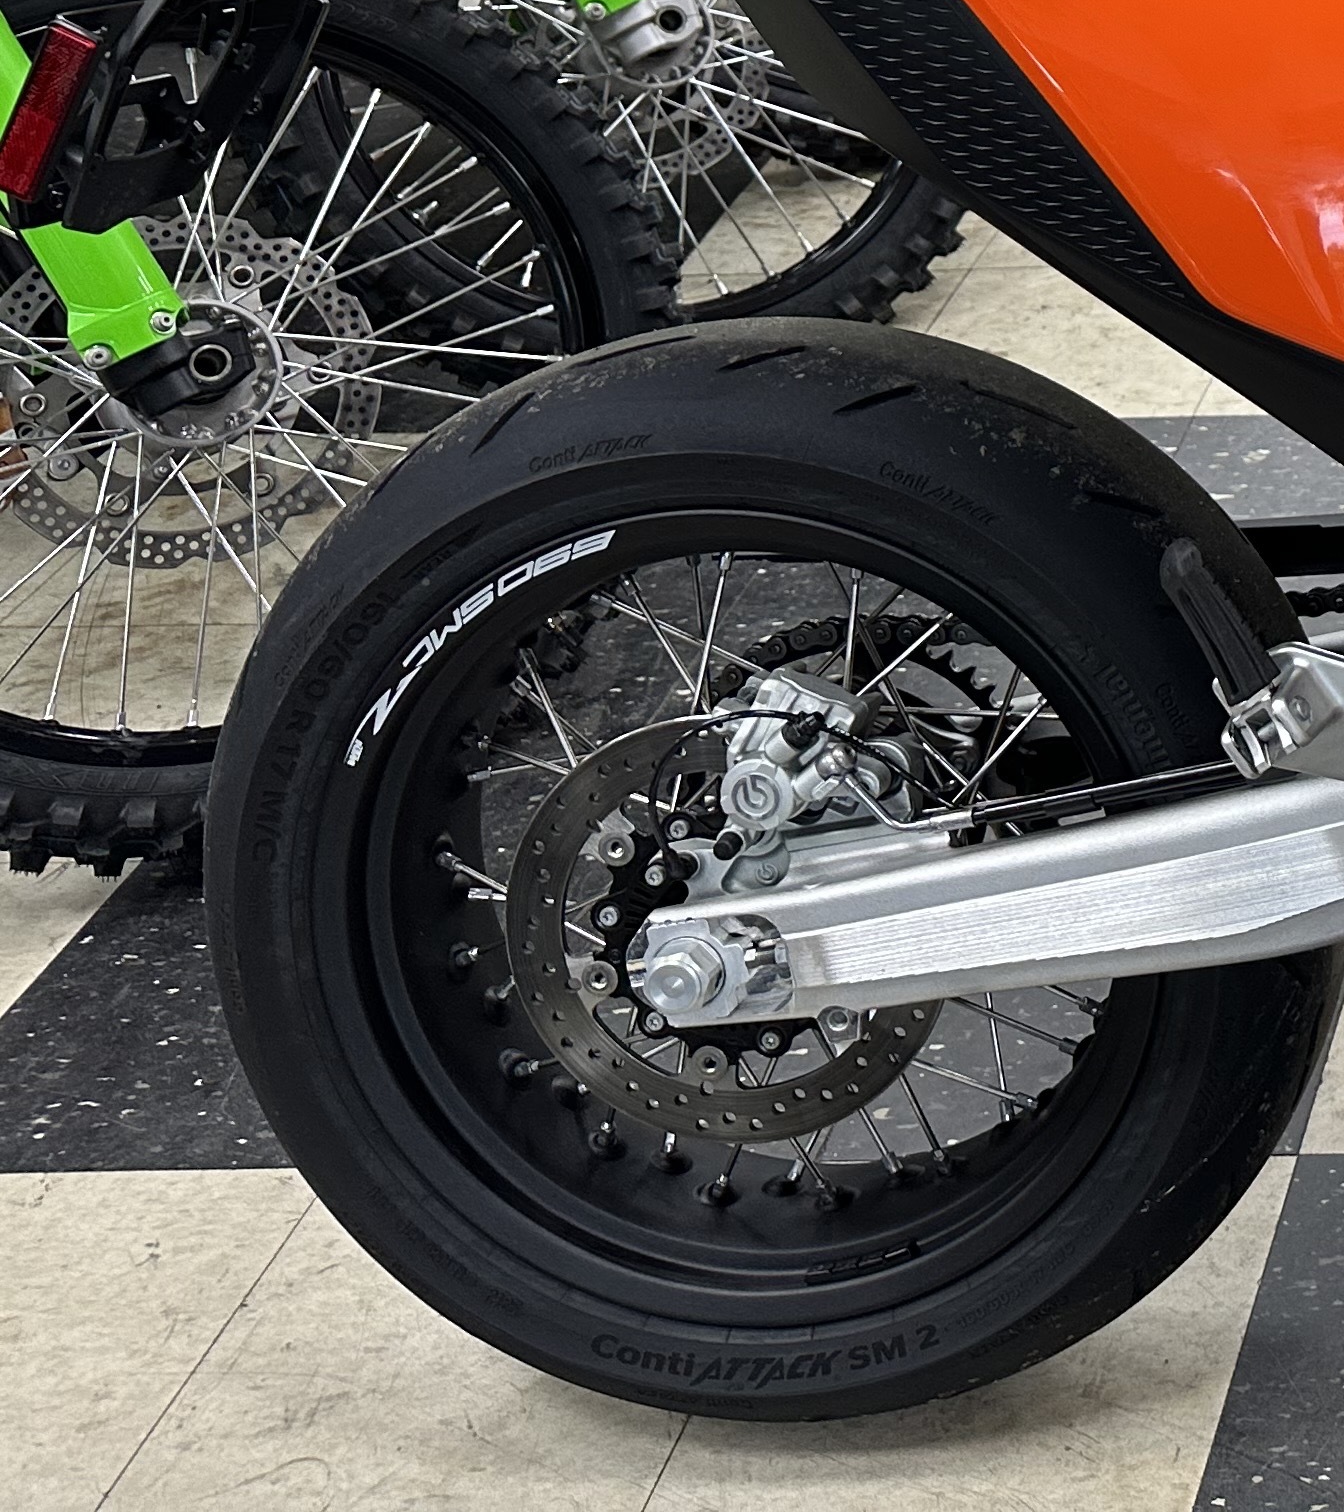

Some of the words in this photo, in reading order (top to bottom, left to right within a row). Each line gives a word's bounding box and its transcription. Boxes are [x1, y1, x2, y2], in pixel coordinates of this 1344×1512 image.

[497, 529, 616, 598] 690
[401, 582, 495, 670] SMC
[590, 1331, 843, 1390] ContiATTACK
[845, 1339, 908, 1371] SM
[914, 1322, 942, 1353] 2
